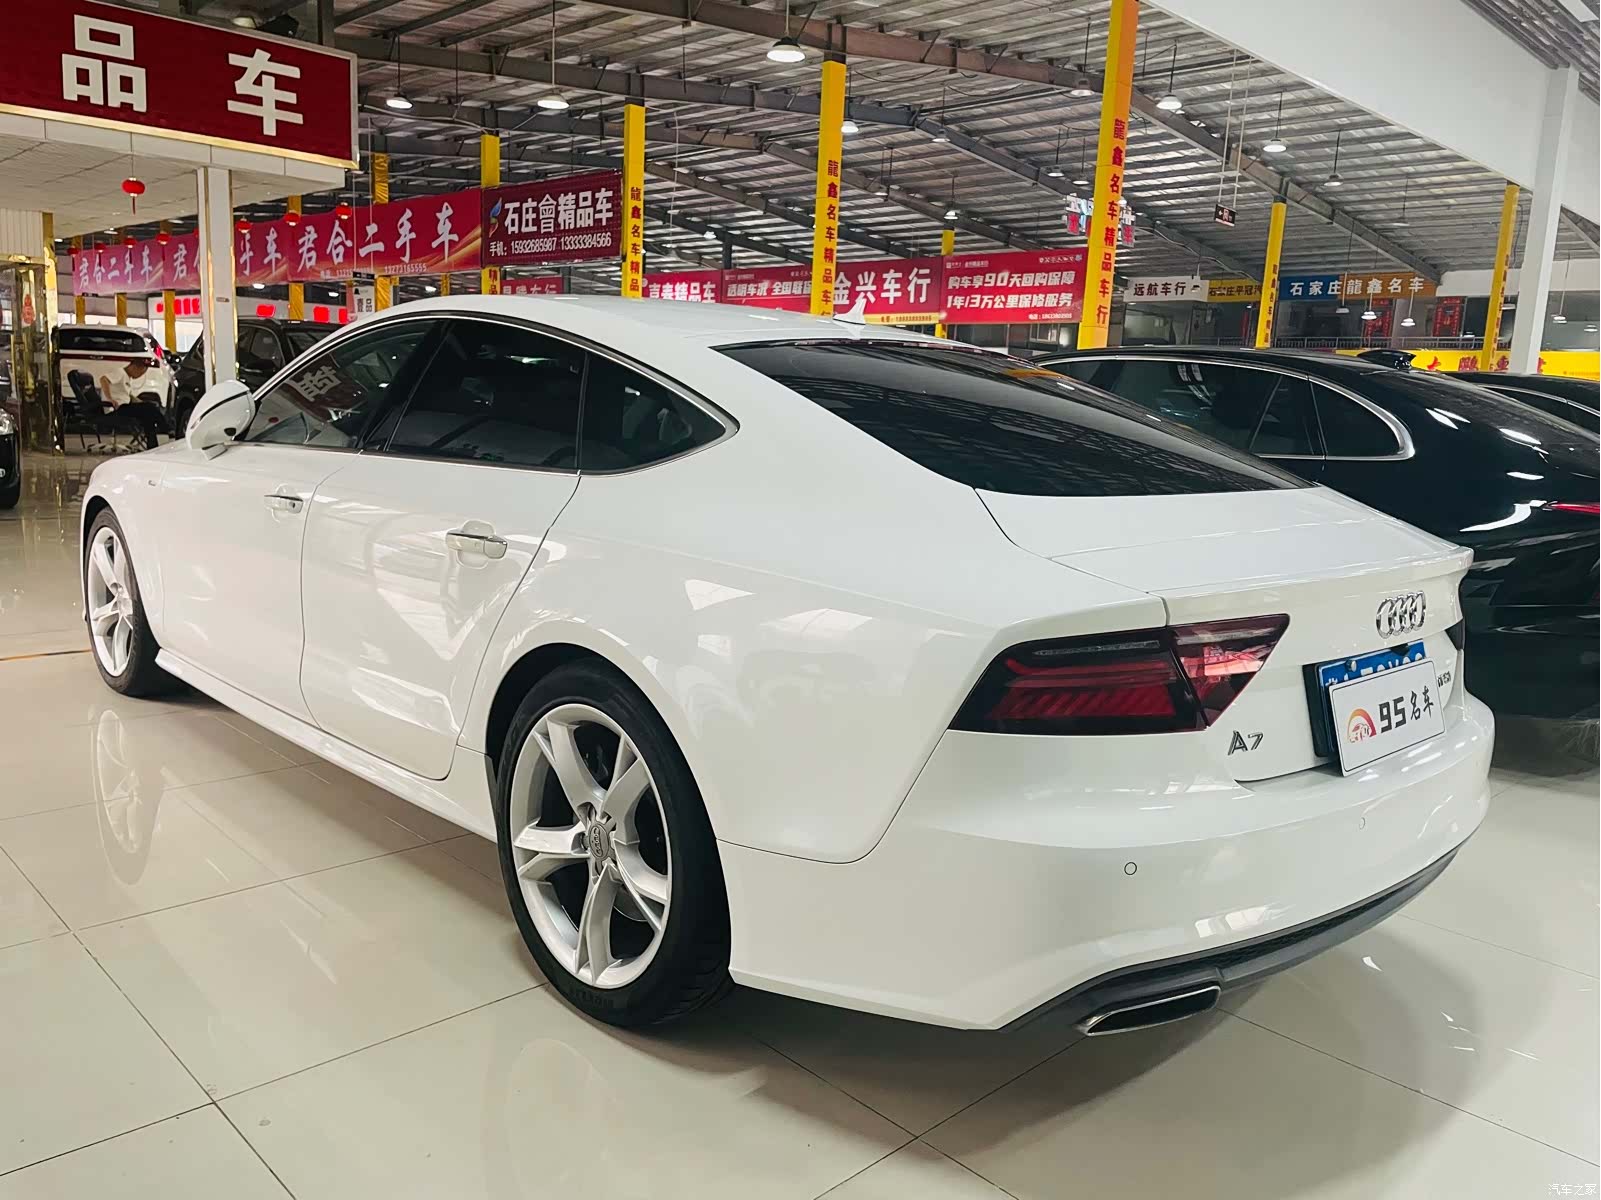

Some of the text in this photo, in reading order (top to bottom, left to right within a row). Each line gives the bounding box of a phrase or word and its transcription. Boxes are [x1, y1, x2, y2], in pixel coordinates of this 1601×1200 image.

[297, 202, 459, 272] 君合二手车
[1096, 118, 1126, 325] 龍鑫名车精品车行
[79, 244, 153, 290] 君合二手车
[833, 267, 932, 305] 金兴车行
[1133, 282, 1187, 297] 远航车行
[1227, 730, 1264, 756] A7
